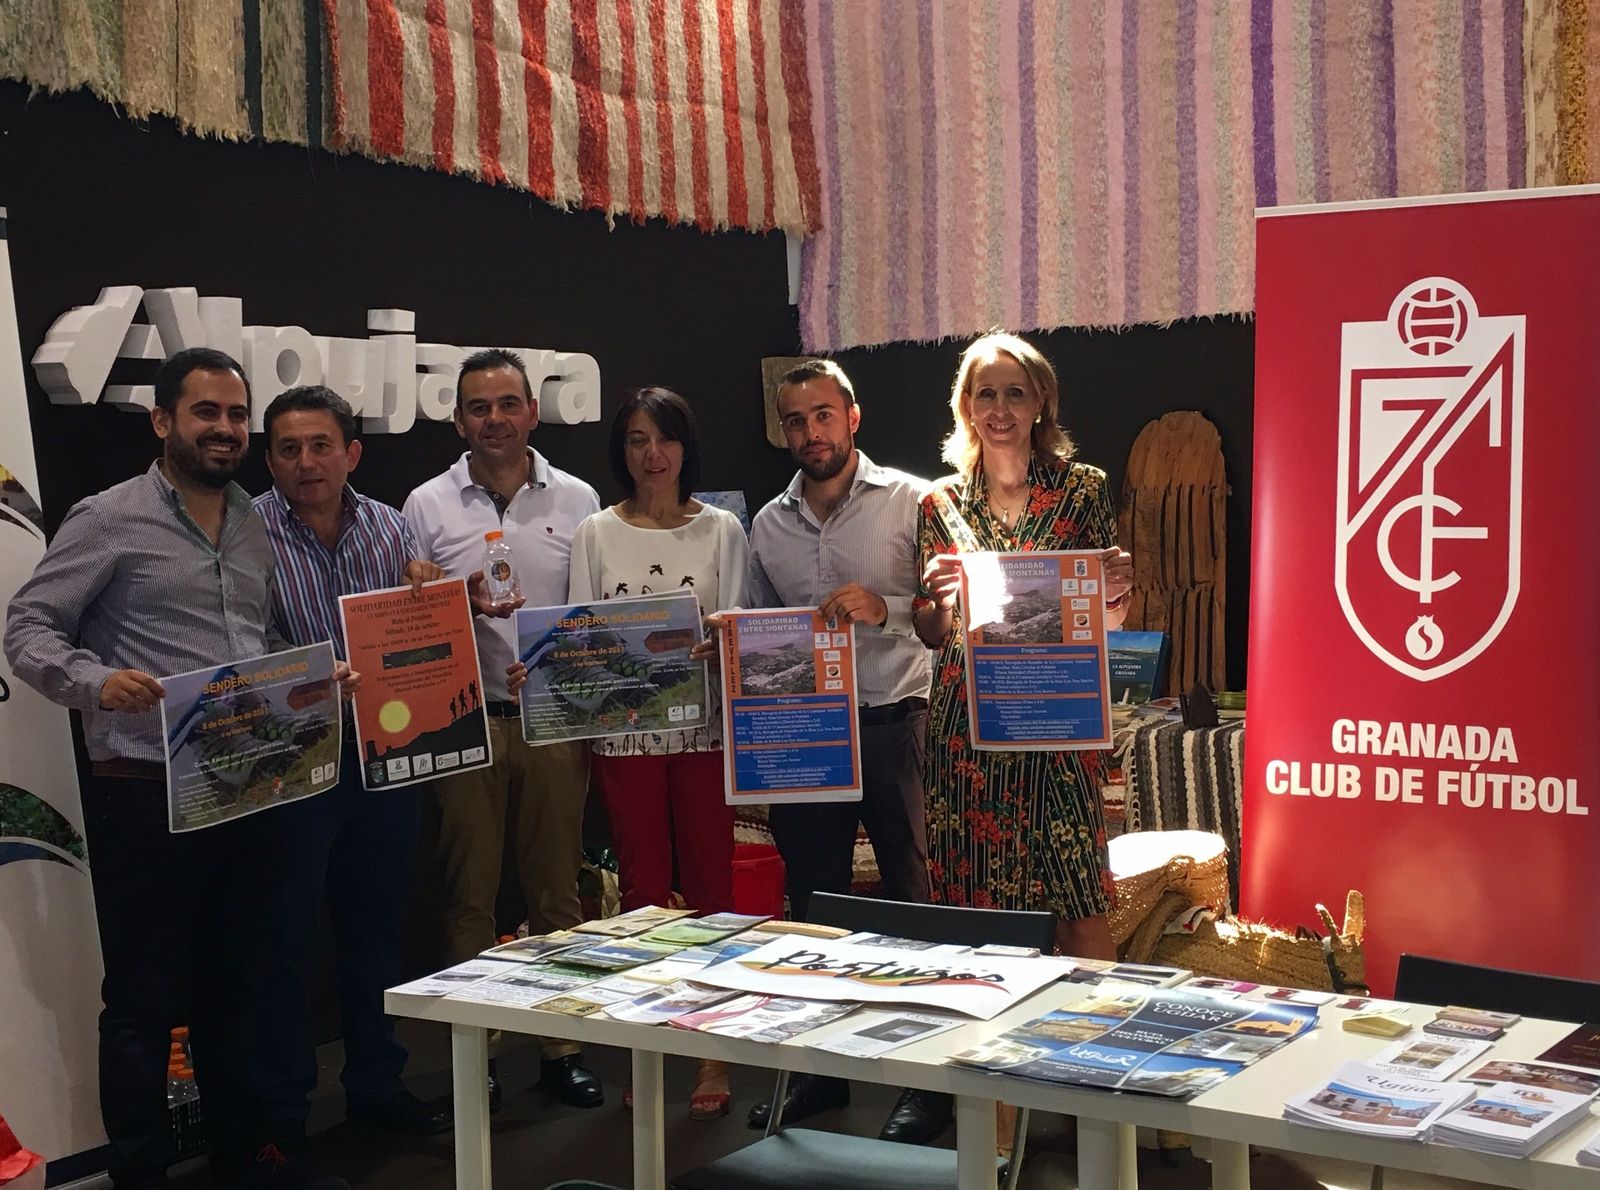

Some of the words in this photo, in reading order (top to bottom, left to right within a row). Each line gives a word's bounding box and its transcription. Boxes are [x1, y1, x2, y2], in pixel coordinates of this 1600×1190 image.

[350, 597, 400, 613] SOLIDARIDAD
[556, 615, 608, 629] SENDERO
[610, 610, 671, 624] SOLIDARIO
[748, 617, 799, 626] SOLIDARIDAD
[739, 625, 763, 634] ENTRE
[570, 648, 597, 657] Octubre
[202, 676, 251, 695] SENDERO
[254, 661, 309, 683] SOLIDARIO
[1331, 718, 1518, 763] GRANADA
[1265, 760, 1362, 800] CLUB
[1375, 767, 1424, 804] DE
[1437, 763, 1589, 816] FÚTBOL
[1152, 1007, 1223, 1023] UGIJAR
[1155, 1001, 1236, 1019] CONOCE
